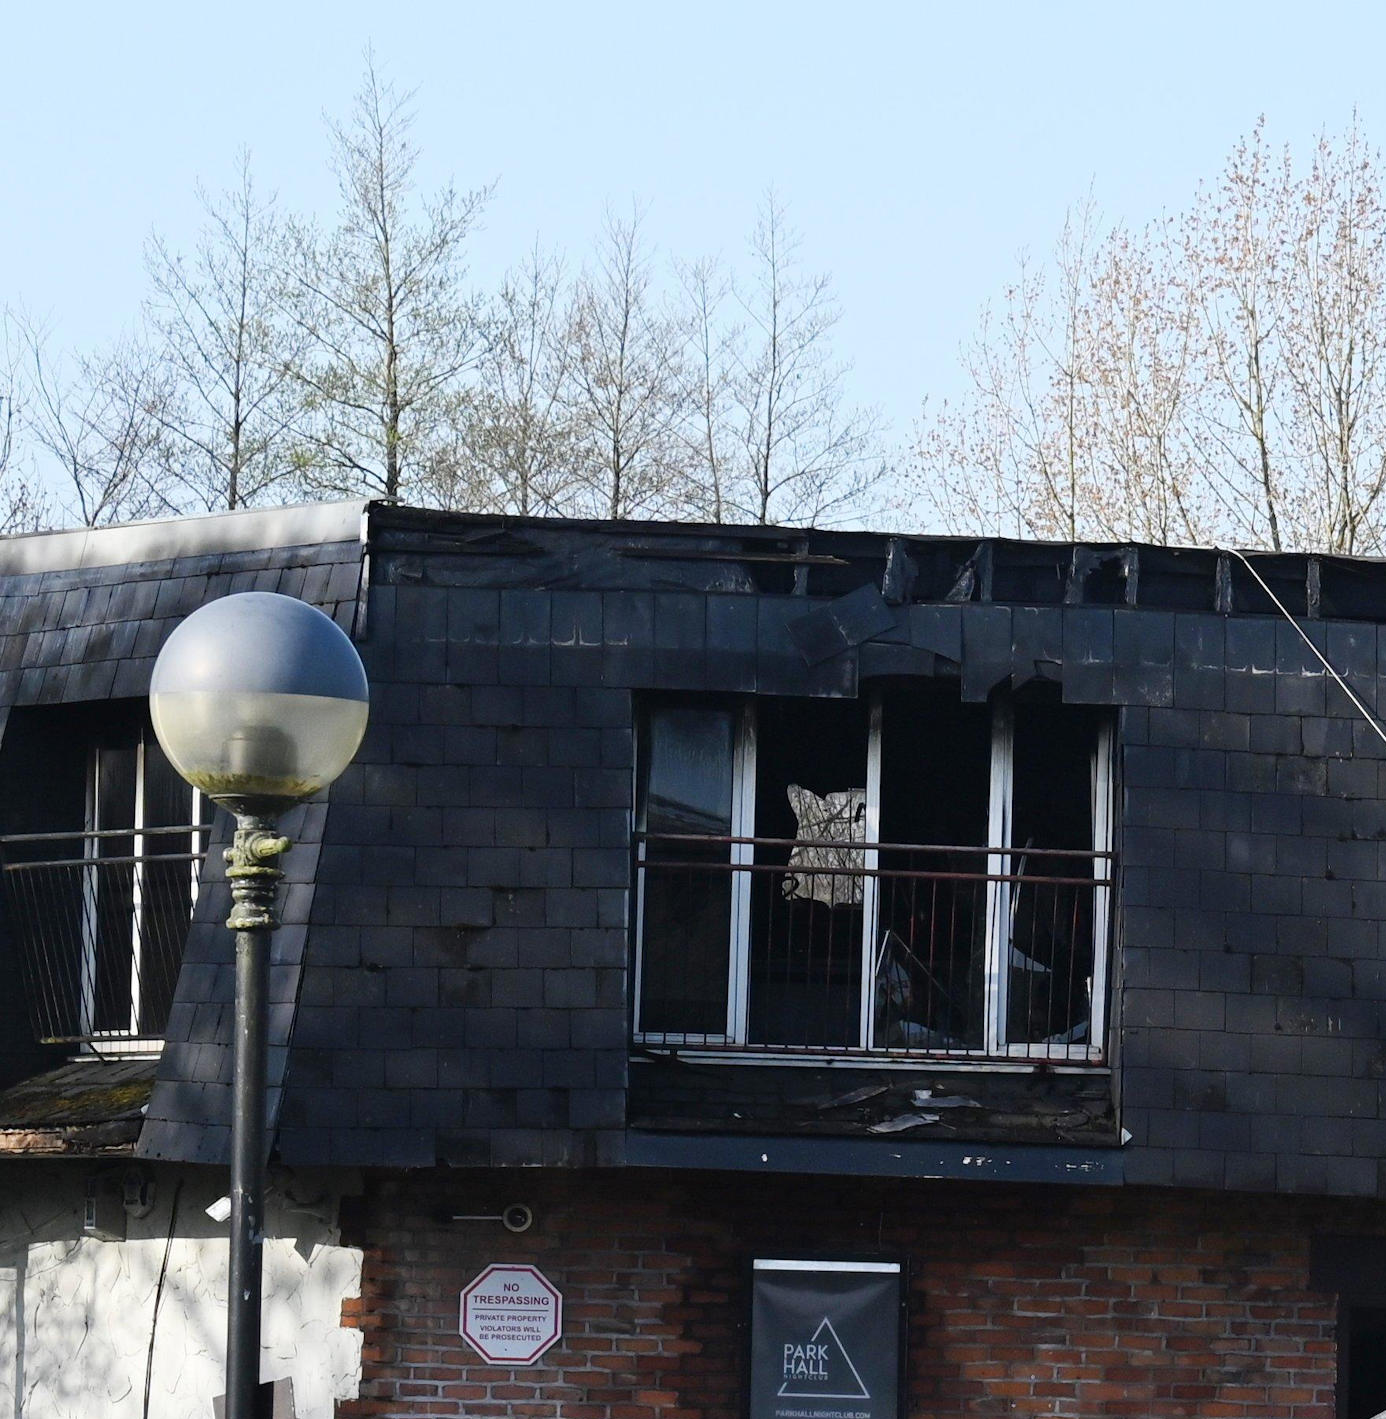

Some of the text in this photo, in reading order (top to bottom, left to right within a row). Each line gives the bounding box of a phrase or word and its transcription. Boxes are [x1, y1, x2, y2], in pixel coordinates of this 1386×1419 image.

[503, 1283, 520, 1292] NO
[473, 1295, 550, 1306] TRESPASSING
[783, 1344, 829, 1360] PARK
[783, 1359, 828, 1375] HALL
[775, 1409, 871, 1419] PARKHALLNIGHTCLUB.COM
